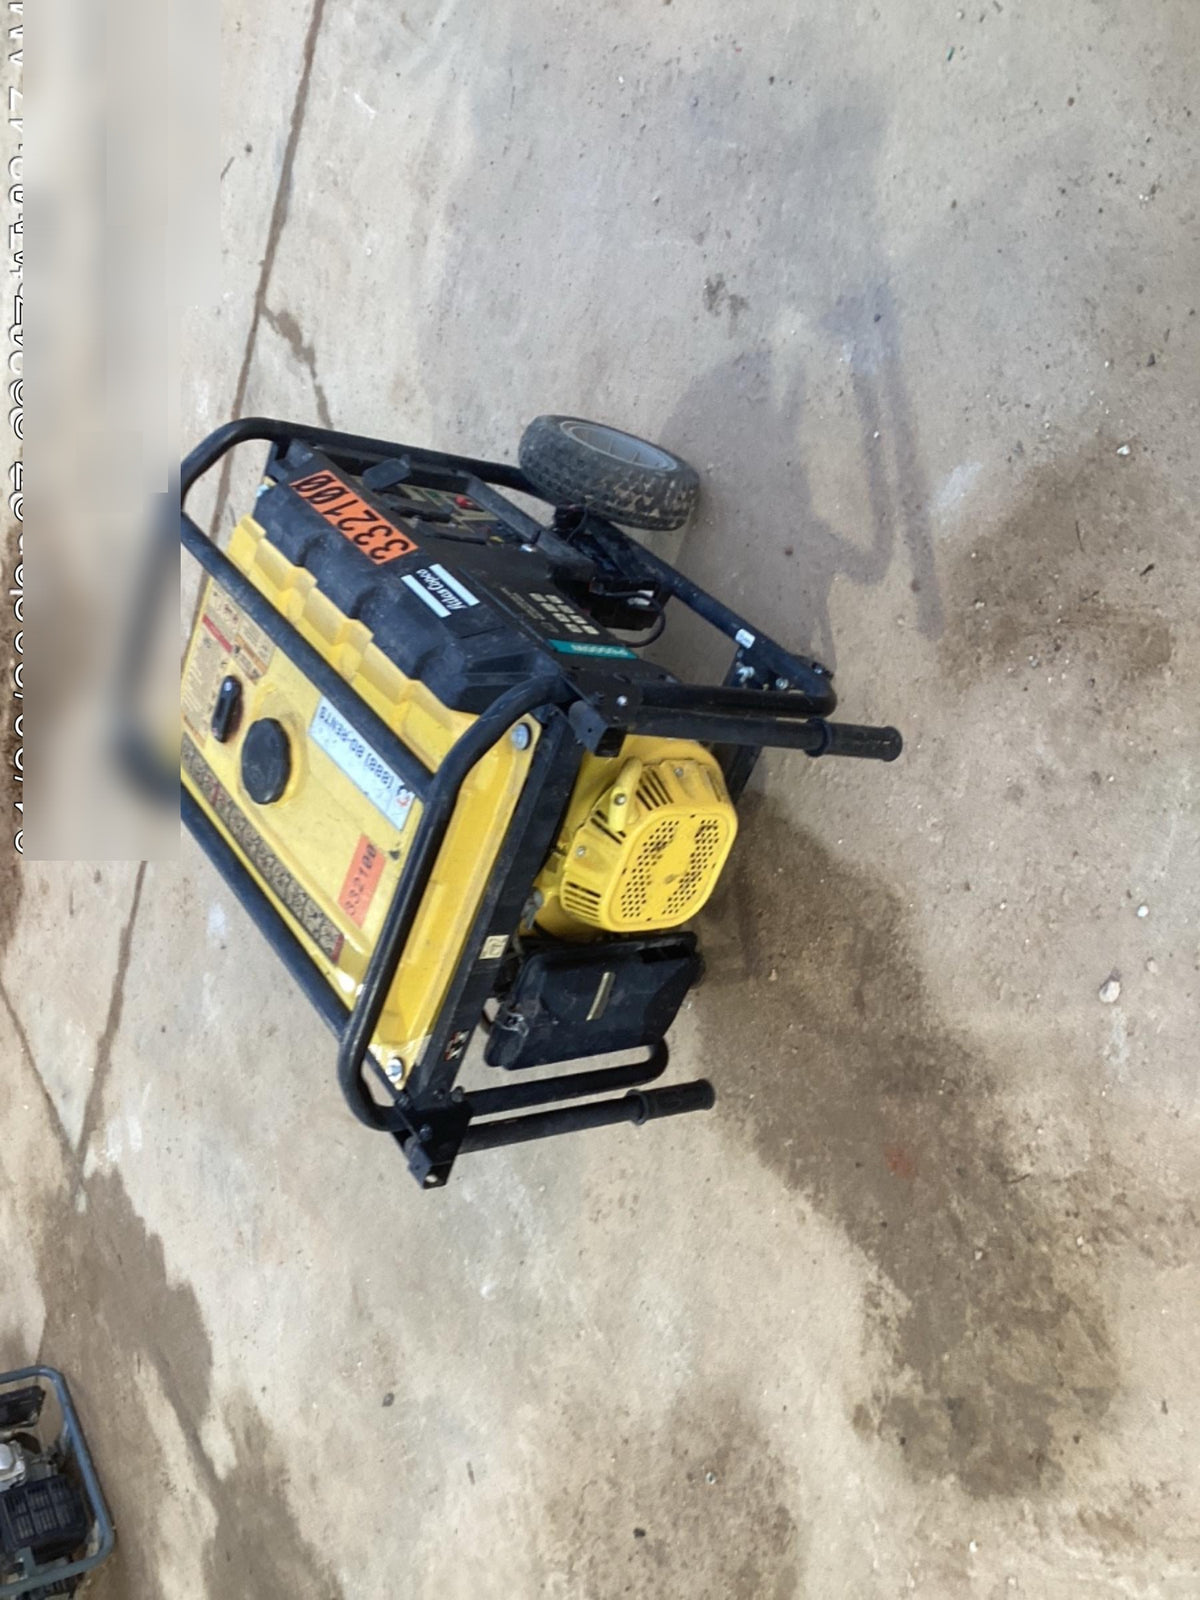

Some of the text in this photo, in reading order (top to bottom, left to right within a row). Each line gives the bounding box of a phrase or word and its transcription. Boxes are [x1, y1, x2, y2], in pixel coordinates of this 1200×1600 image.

[290, 474, 409, 560] 332100
[416, 568, 468, 610] Atlas Copco
[343, 843, 377, 916] 332100
